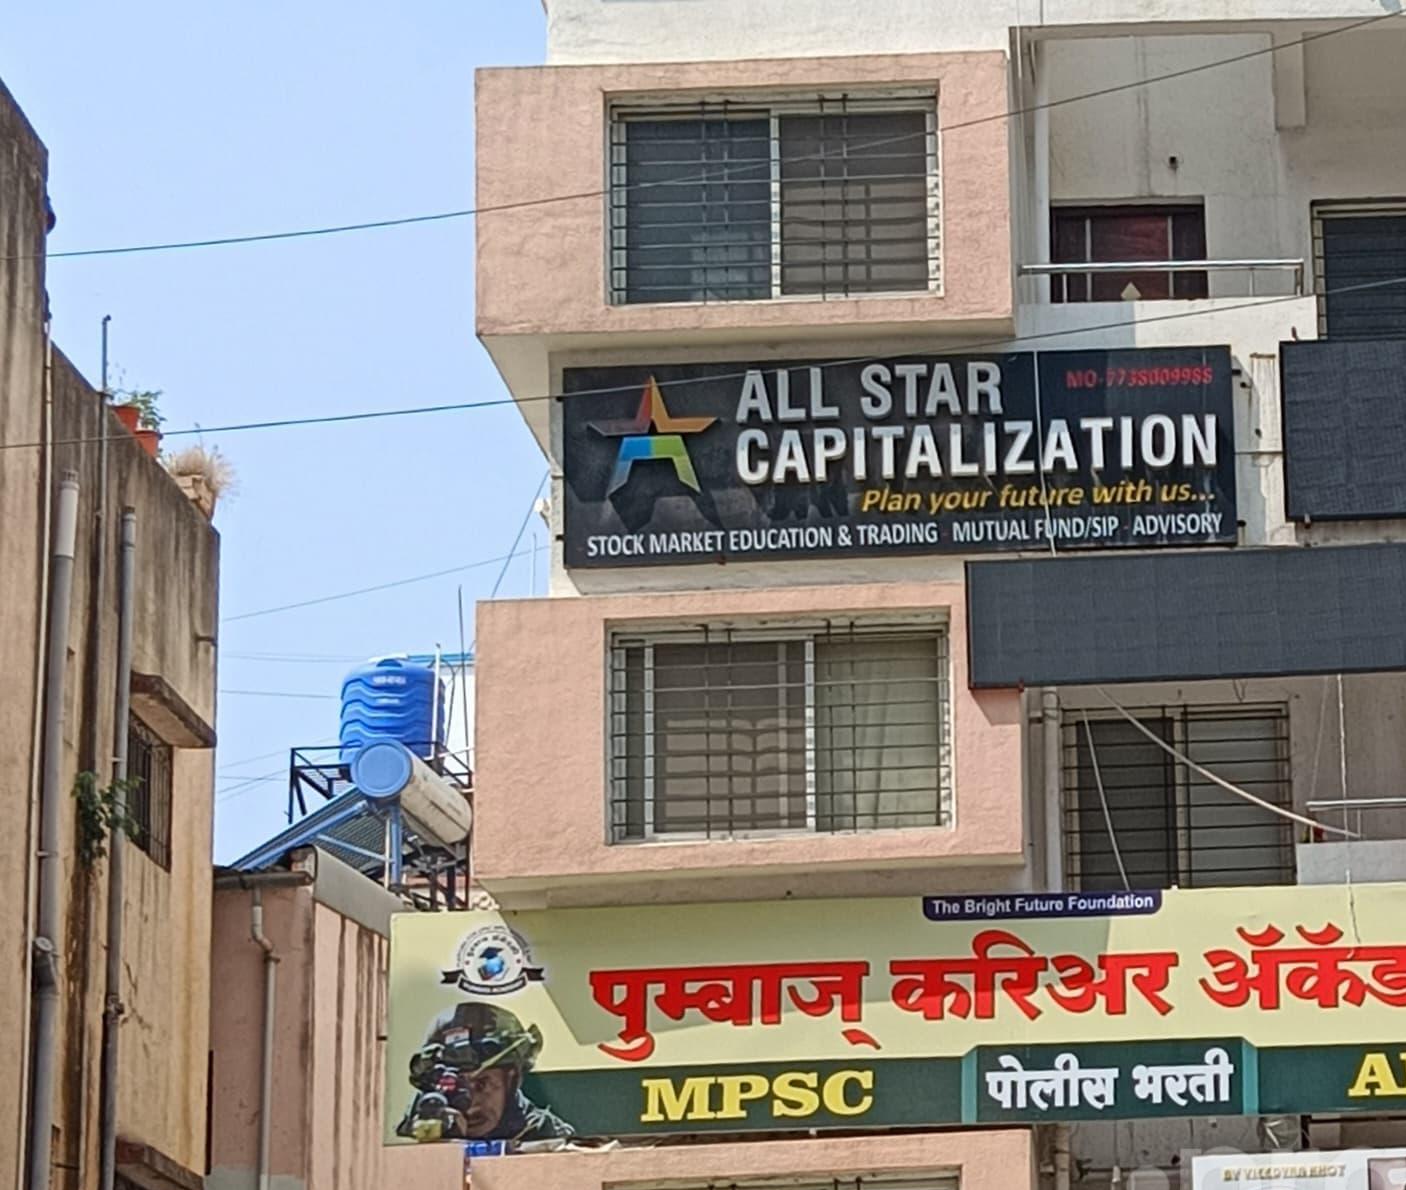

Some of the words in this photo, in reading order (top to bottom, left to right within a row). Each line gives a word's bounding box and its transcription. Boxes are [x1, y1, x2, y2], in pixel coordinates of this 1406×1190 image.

[736, 368, 840, 424] ALL
[859, 360, 1003, 422] STAR
[735, 412, 1218, 485] CAPITALIZATION
[861, 488, 922, 513] Plan
[928, 489, 994, 514] your
[999, 481, 1086, 510] future
[1091, 479, 1154, 506] with
[1159, 482, 1215, 503] us...
[587, 532, 645, 557] STOCK
[648, 529, 727, 555] MARKET
[729, 526, 835, 552] EDUCATION
[837, 525, 854, 546] &
[856, 521, 939, 547] TRADING
[952, 519, 1030, 543] MUTUAL
[1033, 516, 1120, 541] FUND/SIP
[1132, 512, 1224, 537] ADVISORY
[932, 897, 960, 916] The
[963, 896, 1012, 918] Bright
[1015, 895, 1063, 915] Future
[1066, 892, 1155, 913] Foundation
[589, 961, 884, 1062] पुम्बाज्
[888, 929, 1179, 1021] करिअर
[640, 1070, 875, 1123] MPSC
[986, 1053, 1118, 1110] पोलीस
[1130, 1047, 1233, 1107] भरती
